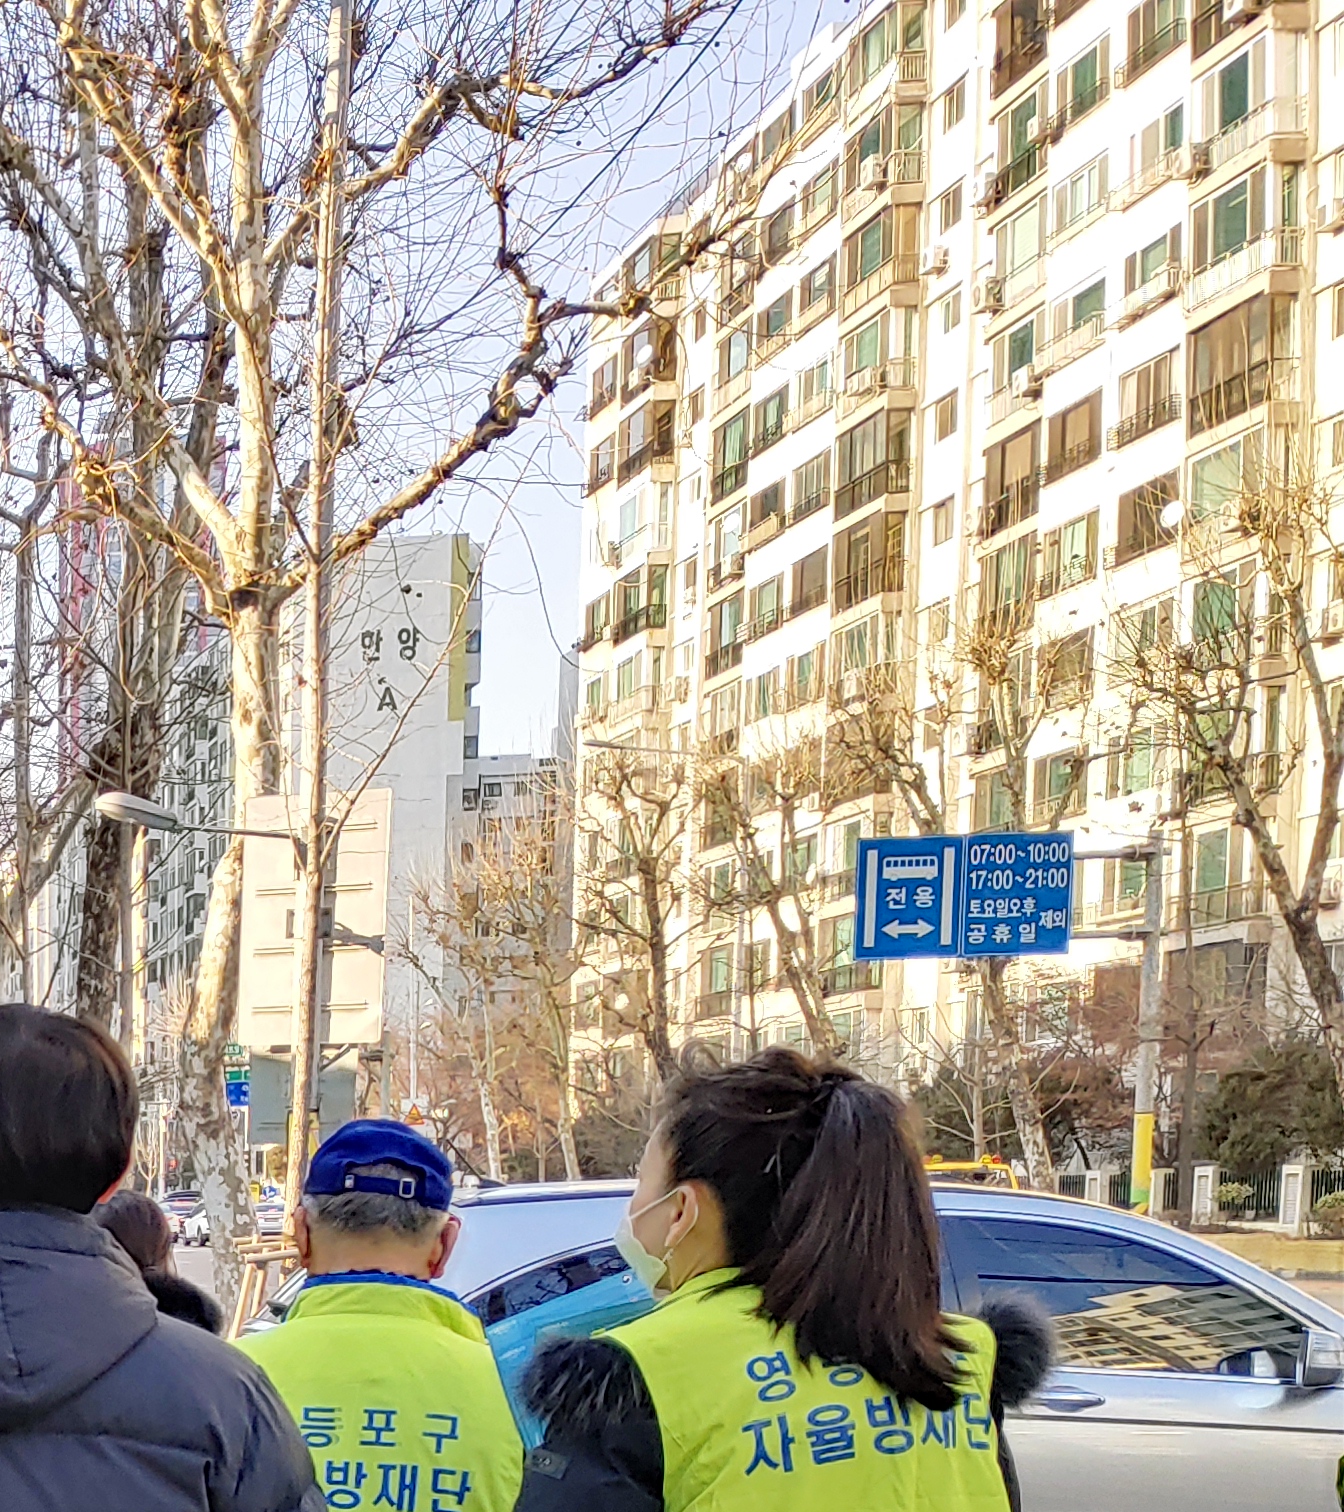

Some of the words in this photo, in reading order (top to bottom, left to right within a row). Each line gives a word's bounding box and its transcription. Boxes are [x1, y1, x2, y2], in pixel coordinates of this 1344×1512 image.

[969, 842, 1069, 866] 07:00~10:00
[968, 867, 1068, 890] 17:00~21:00
[885, 885, 936, 910] 전용
[1038, 907, 1067, 930] 제외
[966, 922, 1037, 944] 공휴일
